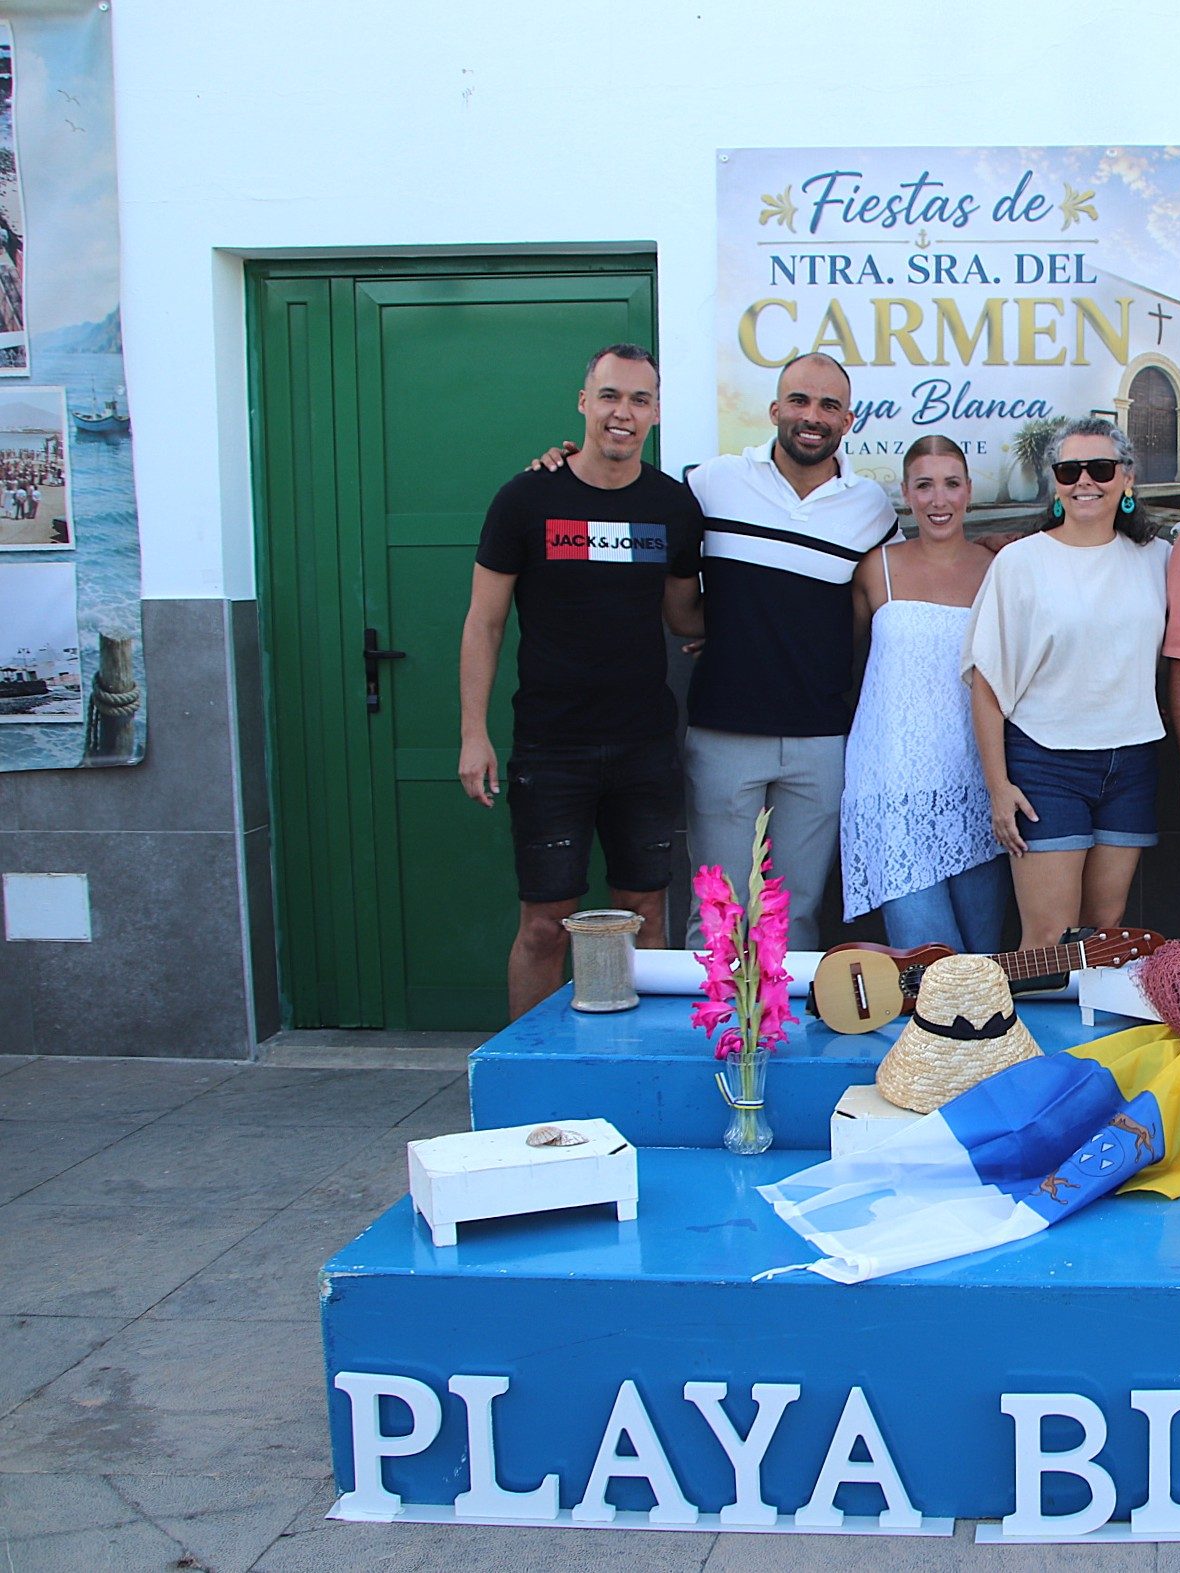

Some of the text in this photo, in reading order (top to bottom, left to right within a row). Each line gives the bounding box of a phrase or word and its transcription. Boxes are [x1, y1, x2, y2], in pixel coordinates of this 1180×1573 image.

[802, 169, 1055, 234] Fiestas de
[769, 253, 1098, 286] NTRA. SRA. DEL
[738, 297, 1135, 368] CARMEN
[911, 378, 1053, 426] Blanca
[845, 440, 988, 455] LANZTE
[334, 1370, 924, 1529] PLAYA
